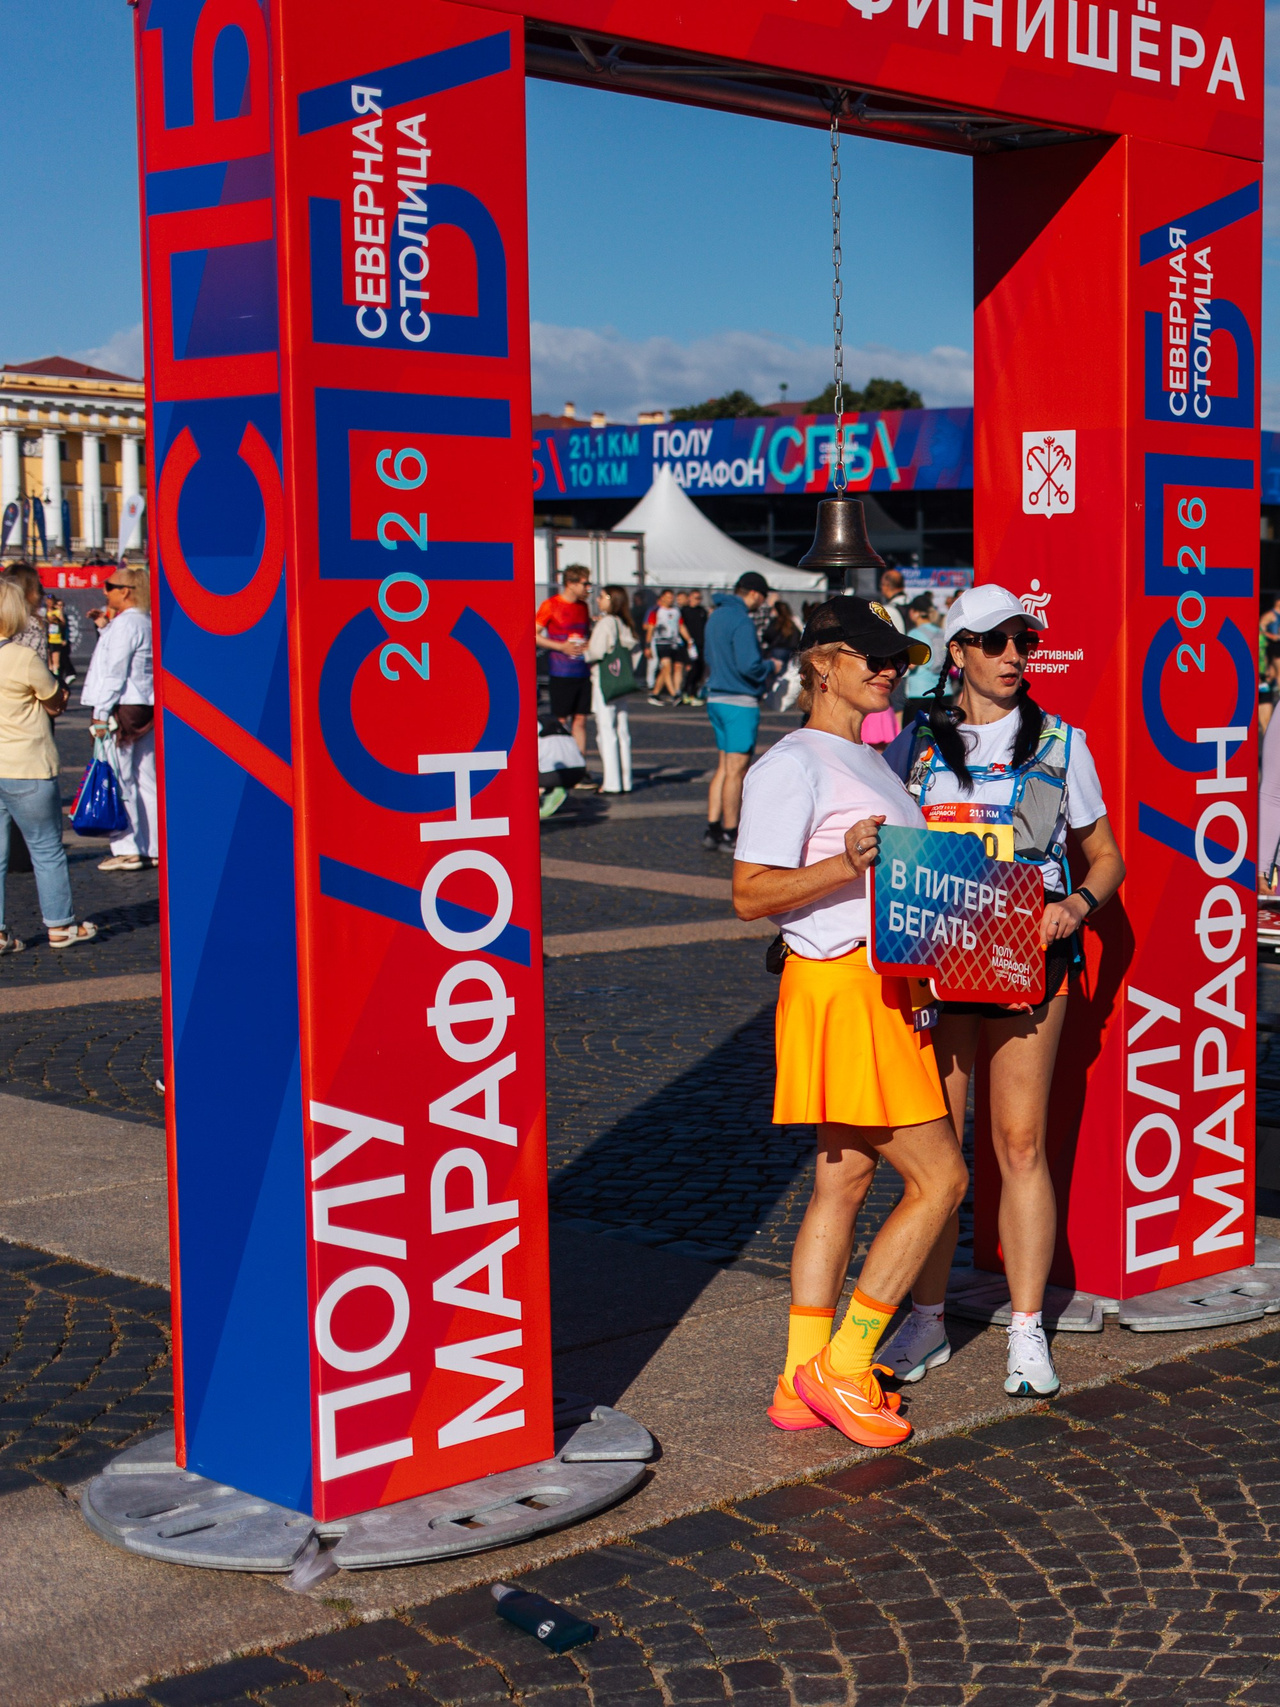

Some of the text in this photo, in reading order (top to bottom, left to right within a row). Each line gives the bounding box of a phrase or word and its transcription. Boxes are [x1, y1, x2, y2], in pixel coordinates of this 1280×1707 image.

[351, 84, 388, 340] СЕВЕРНАЯ
[395, 113, 432, 343] СТОЛИЦА
[1168, 226, 1188, 418] СЕВЕРНАЯ
[1193, 246, 1212, 419] СТОЛИЦА
[569, 432, 639, 460] 21,1 КМ
[652, 428, 713, 459] ПОЛУ
[570, 464, 593, 488] 10
[597, 462, 628, 486] КМ
[376, 447, 430, 681] 2026
[1177, 496, 1207, 674] 2026
[1024, 662, 1070, 674] ЕТЕРБУРГ
[1027, 648, 1084, 661] ОРТИВНЫЙ
[969, 809, 999, 819] 21,1 КМ
[891, 858, 907, 891] В
[915, 865, 1008, 919] ПИТЕРЕ
[889, 900, 978, 951] БЕГАТЬ
[993, 944, 1014, 959] ПОЛУ
[992, 956, 1030, 975] МАРАФОН
[1193, 726, 1249, 1256] МАРАФОН
[920, 1009, 930, 1027] D
[418, 750, 526, 1450] МАРАФОН
[1126, 986, 1181, 1274] ПОЛУ
[309, 1100, 414, 1483] ПОЛУ
